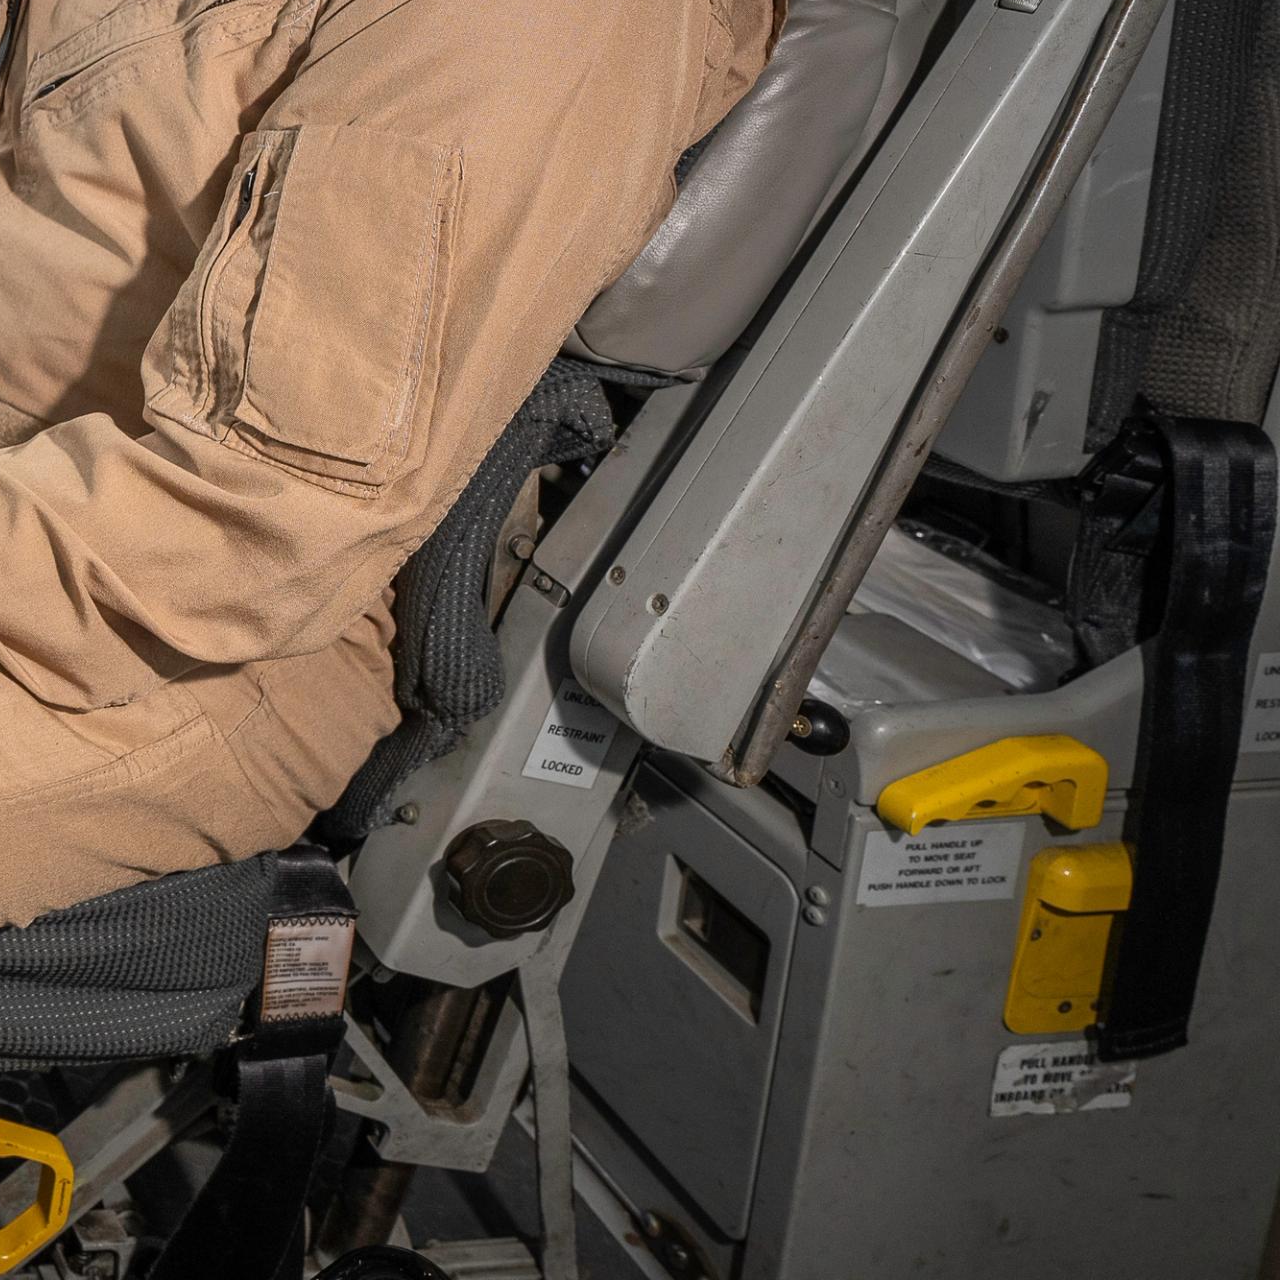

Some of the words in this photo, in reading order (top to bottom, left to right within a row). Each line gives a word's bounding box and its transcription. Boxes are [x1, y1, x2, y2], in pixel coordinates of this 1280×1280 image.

[563, 691, 602, 707] UNLOC
[547, 724, 606, 744] RESTRAINT
[541, 759, 584, 776] LOCKED
[905, 843, 927, 851] PULL
[931, 841, 968, 849] HANDLE
[970, 839, 984, 847] UP
[924, 854, 949, 862] MOVE
[953, 852, 976, 861] SEAT
[898, 867, 943, 877] FORWARD
[946, 866, 960, 874] OR
[963, 865, 981, 873] AFT
[868, 883, 892, 891] PUSH
[896, 880, 931, 889] HANDLE
[935, 878, 963, 887] DOWN
[967, 877, 978, 885] TO
[981, 875, 1007, 884] LOCK
[1020, 1058, 1046, 1069] PULL
